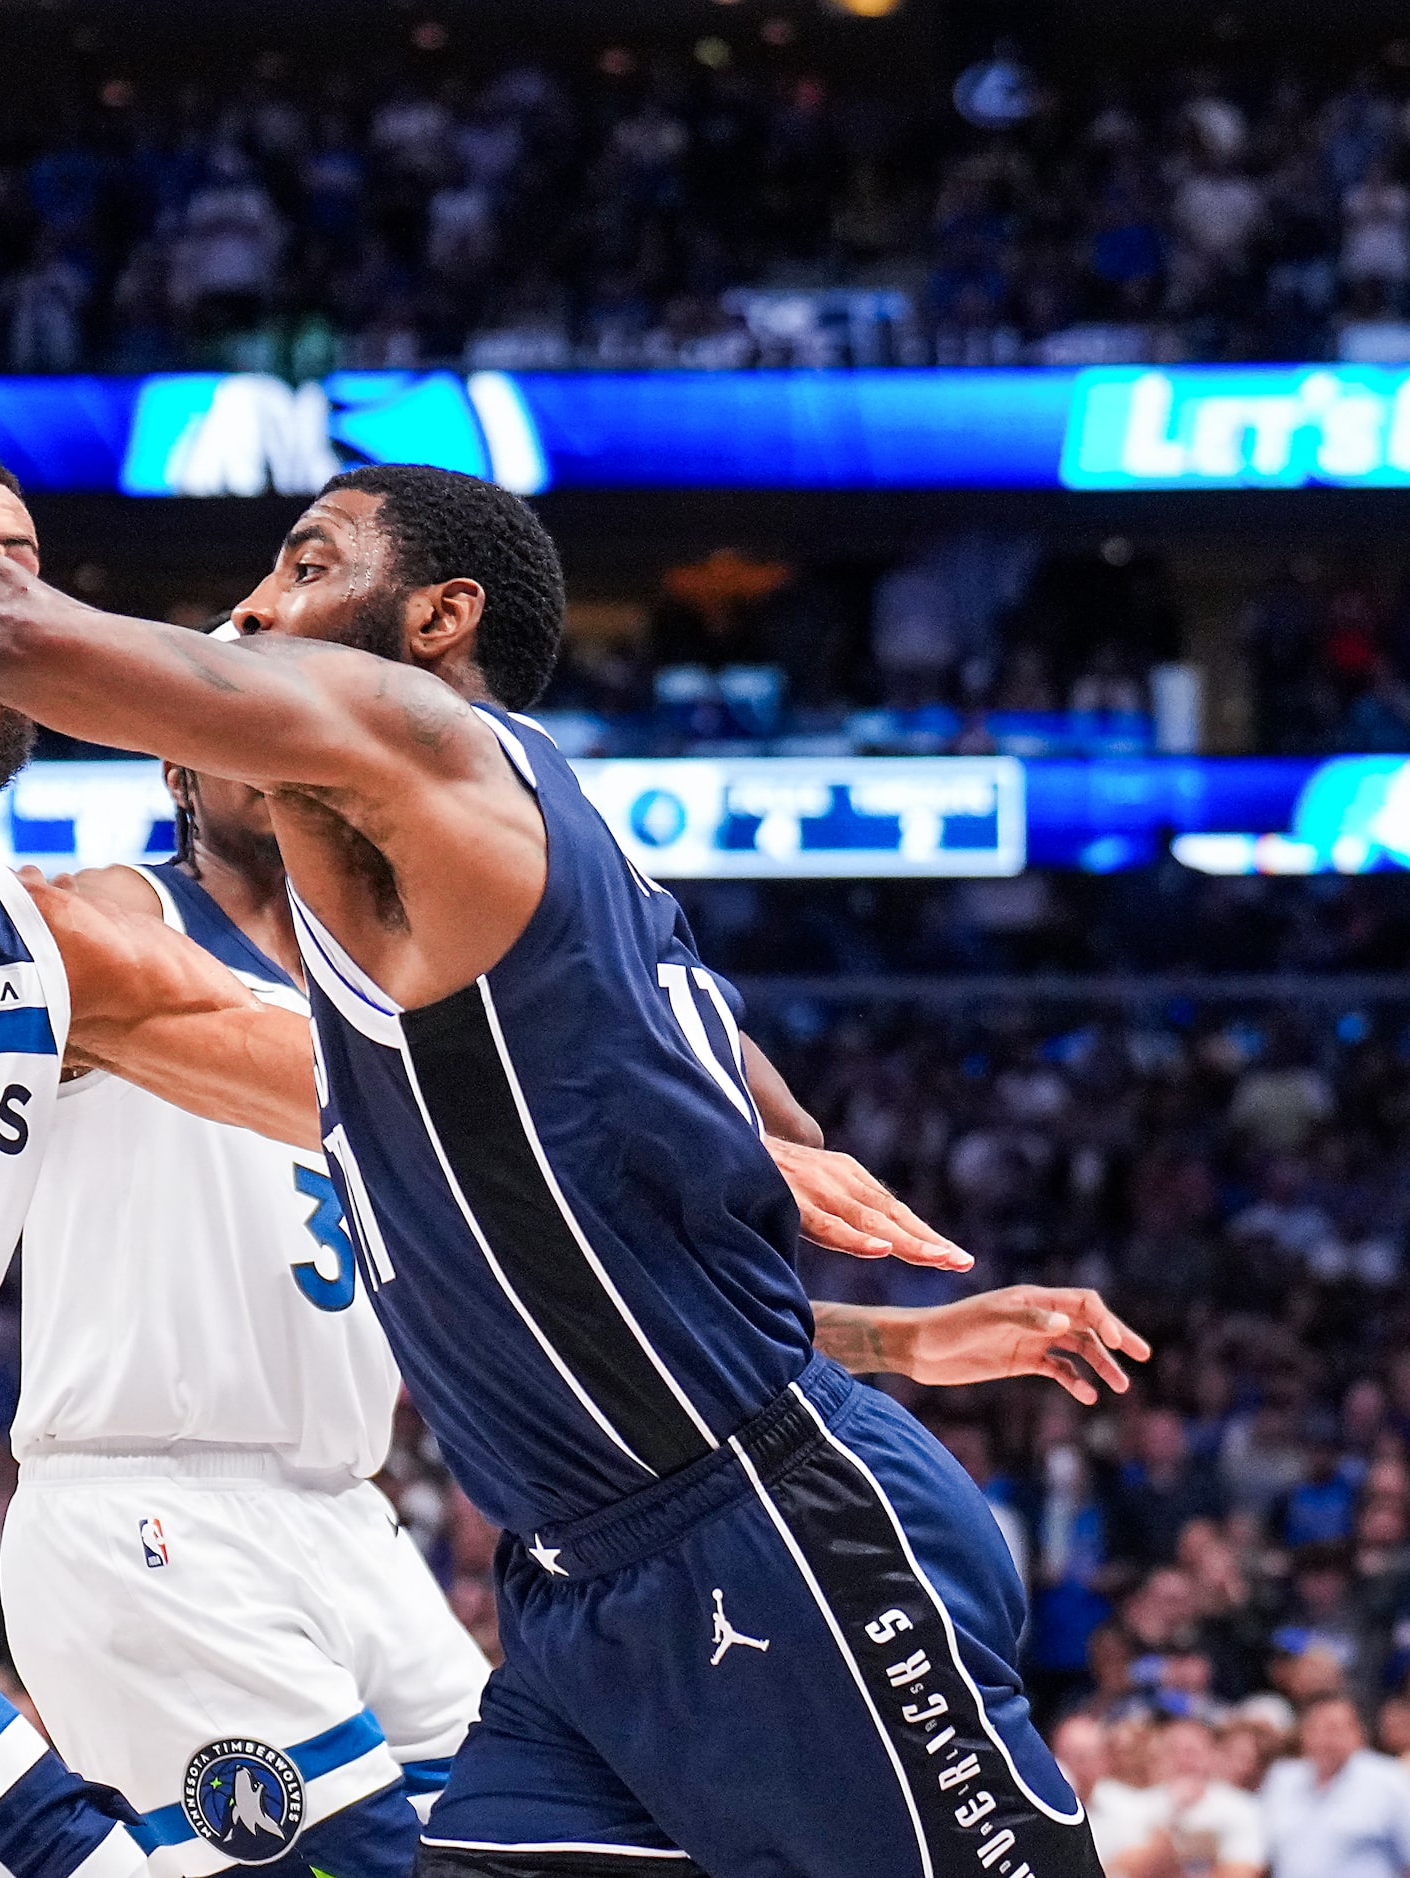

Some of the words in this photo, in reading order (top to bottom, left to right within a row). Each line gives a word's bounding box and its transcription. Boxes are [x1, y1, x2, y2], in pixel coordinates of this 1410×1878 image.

[657, 962, 765, 1142] 11
[186, 1754, 212, 1838] MINNESOTA
[213, 1741, 302, 1823] TIMBERWOLVES
